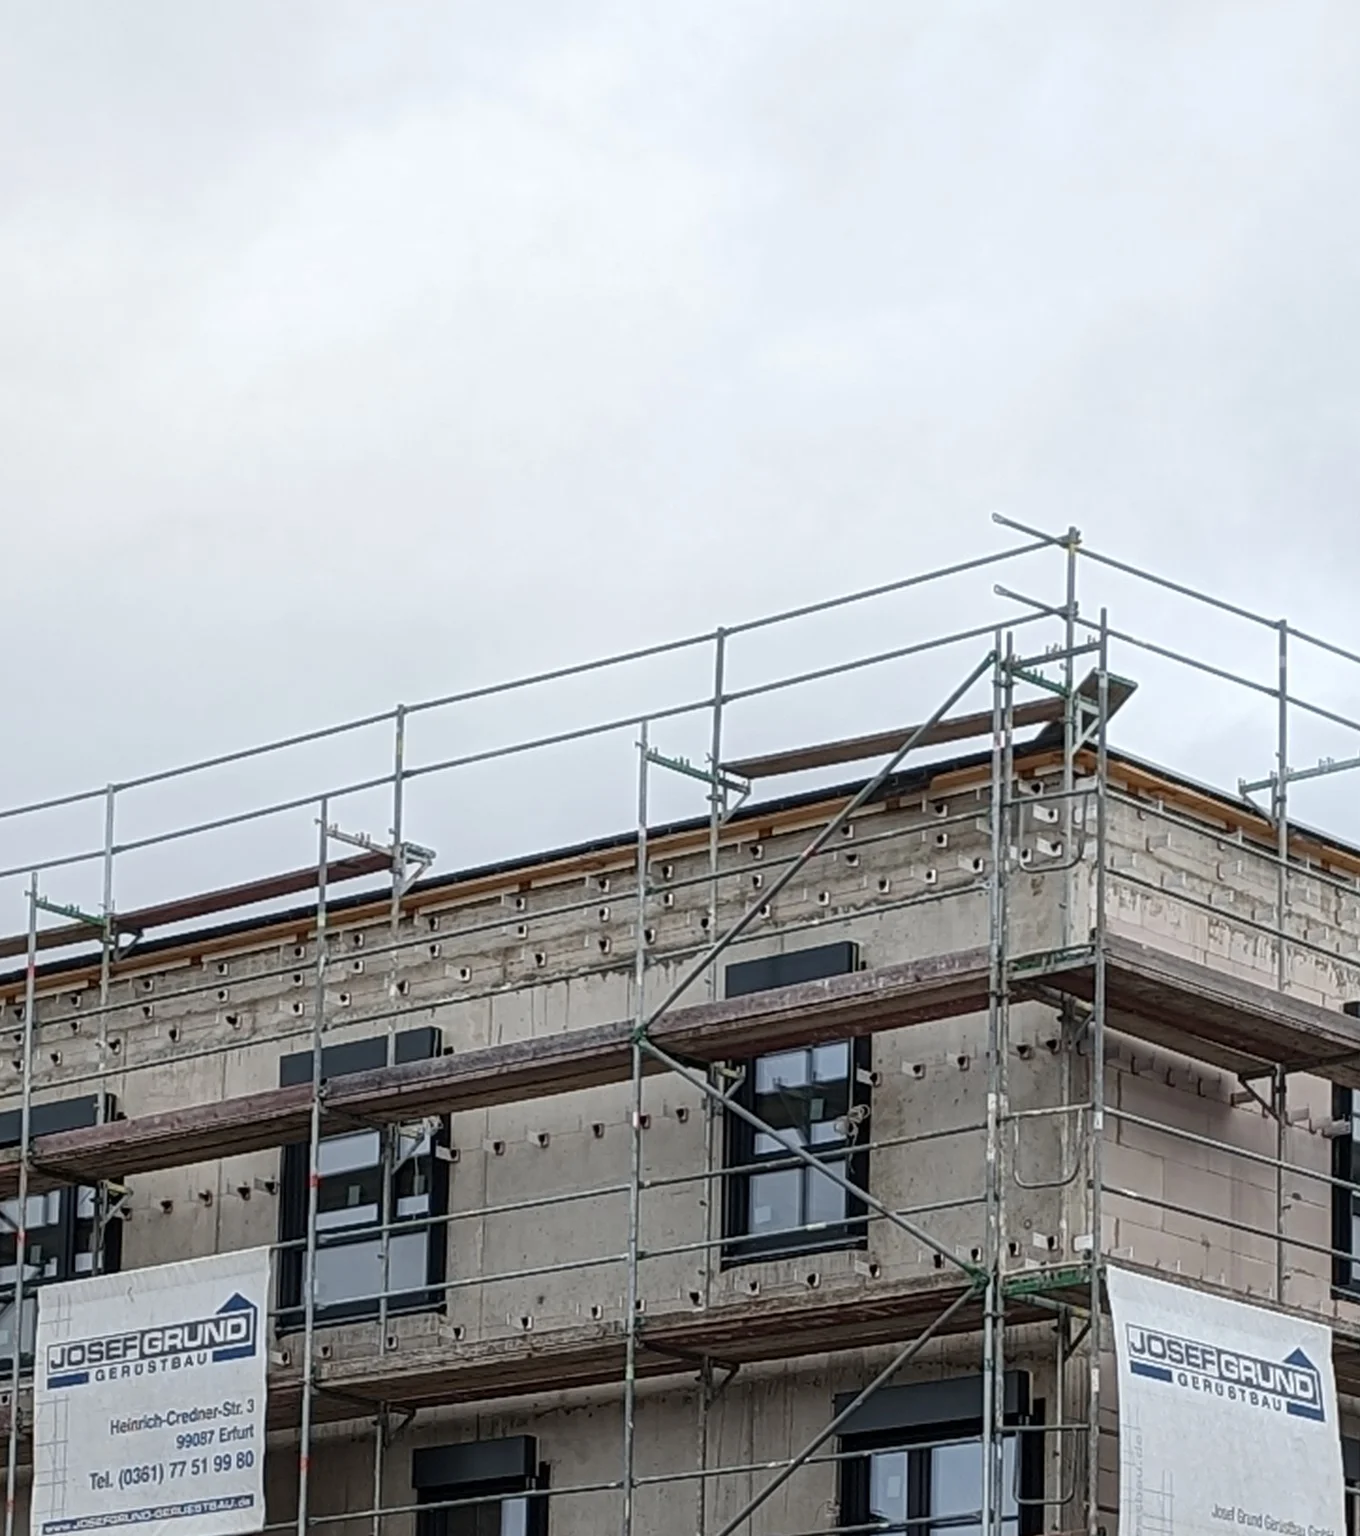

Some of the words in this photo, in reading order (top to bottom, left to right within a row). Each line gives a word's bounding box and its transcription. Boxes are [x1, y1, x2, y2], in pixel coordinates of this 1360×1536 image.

[50, 1336, 138, 1370] JOSEF
[142, 1317, 247, 1356] GRUND
[95, 1352, 208, 1382] GERÜSTBAU
[1131, 1331, 1217, 1370] JOSEF
[1220, 1353, 1314, 1400] GRUND
[110, 1402, 243, 1435] Heinrich-Credner-Str.
[246, 1398, 255, 1414] 3
[176, 1430, 214, 1450] 99087
[219, 1424, 254, 1443] Erfurt
[90, 1471, 114, 1491] Tel.
[119, 1464, 165, 1491] (0361)
[170, 1460, 186, 1479] 77
[192, 1457, 208, 1476] 51
[213, 1454, 232, 1473] 99
[236, 1450, 254, 1469] 80
[1211, 1503, 1235, 1522] Josef
[1237, 1509, 1263, 1528] Grund
